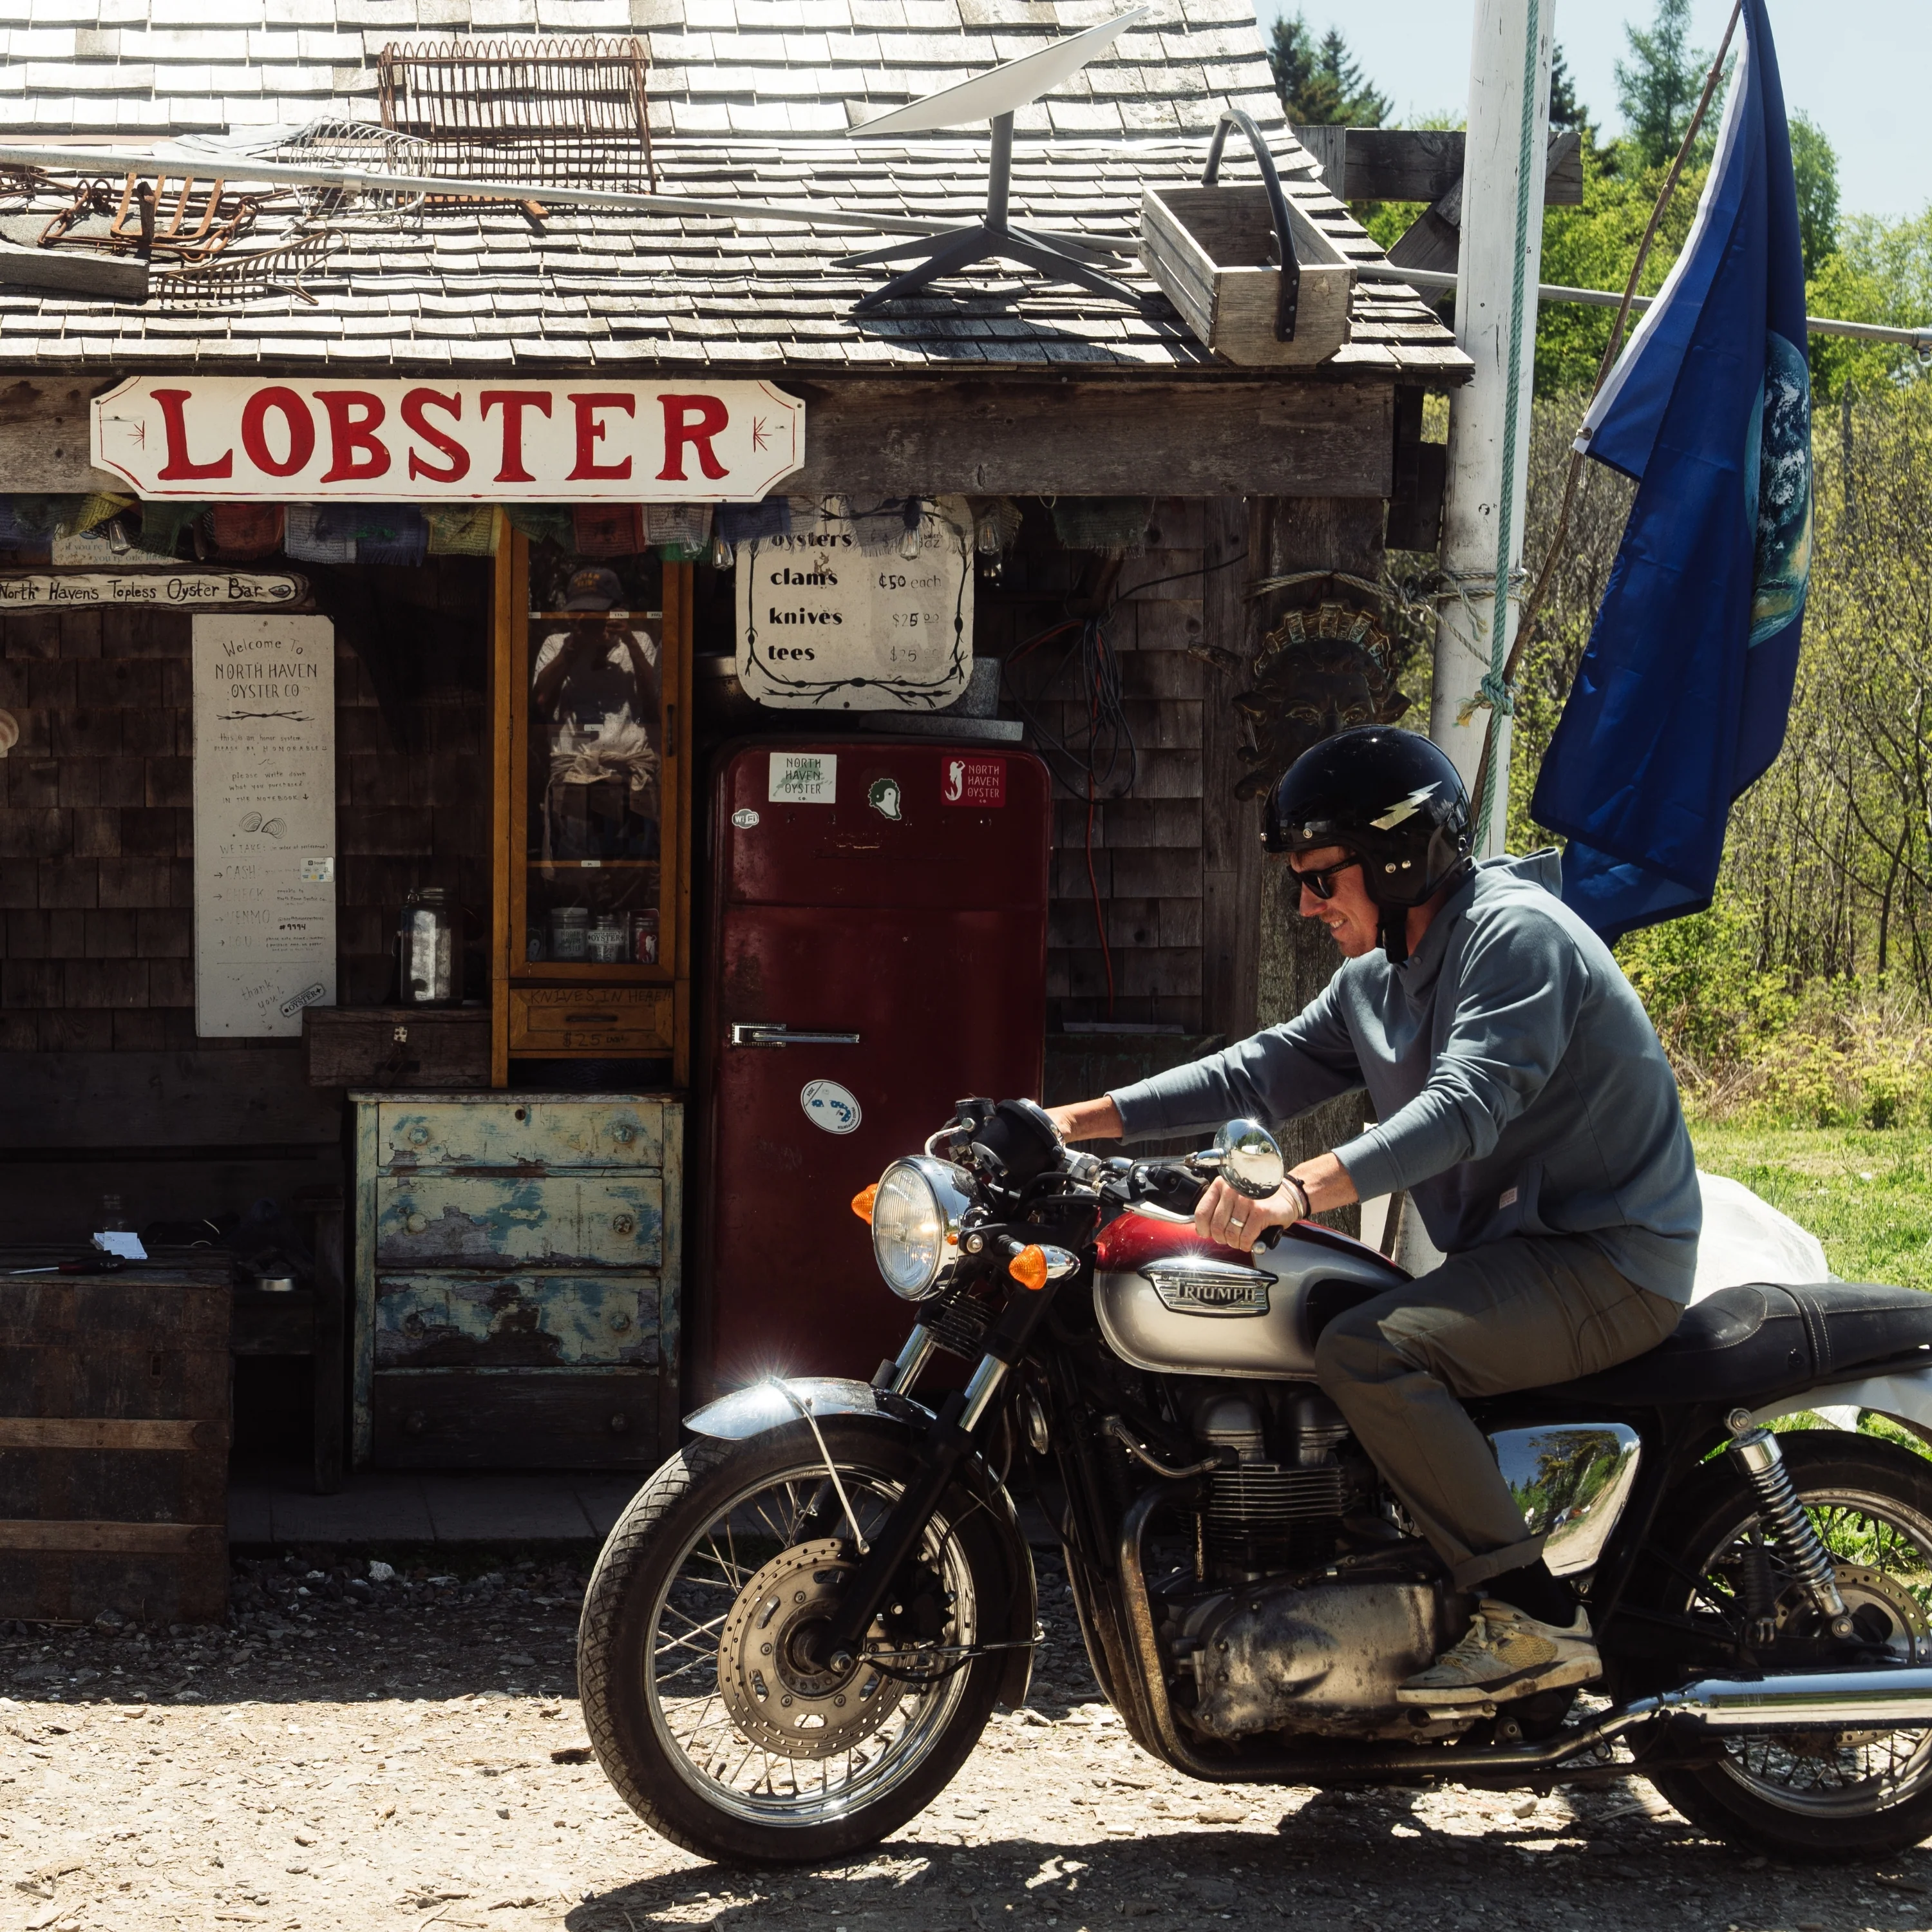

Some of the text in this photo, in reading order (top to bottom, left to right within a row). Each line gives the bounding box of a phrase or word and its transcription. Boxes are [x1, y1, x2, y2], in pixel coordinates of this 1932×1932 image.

[150, 386, 730, 484] LOBSTER
[772, 532, 853, 551] oysters
[770, 568, 838, 586] clams
[910, 575, 942, 589] each
[0, 577, 263, 602] North Haven's Topless Oyster Bar
[770, 607, 843, 625] knives
[222, 638, 303, 658] Welcome To
[768, 645, 815, 661] tees
[215, 663, 317, 679] NORTH HAVEN
[231, 684, 299, 699] OYSTER CO
[219, 733, 234, 741] this
[786, 758, 821, 768] NORTH
[969, 764, 999, 775] NORTH
[232, 772, 258, 781] please
[786, 770, 820, 781] HAVEN
[968, 776, 999, 786] HAVEN
[785, 783, 821, 794] OYSTER
[967, 788, 999, 798] OYSTER
[220, 844, 234, 854] WE
[226, 888, 265, 902] CHECK
[242, 980, 274, 1001] thank
[531, 989, 594, 1004] KNIVES
[601, 989, 621, 1003] IN
[289, 990, 317, 1011] OYSTER
[562, 1031, 602, 1048] $25
[806, 1087, 815, 1097] 2024
[837, 1119, 856, 1130] SUPPORTER
[1173, 1279, 1256, 1302] TRIUMPH
